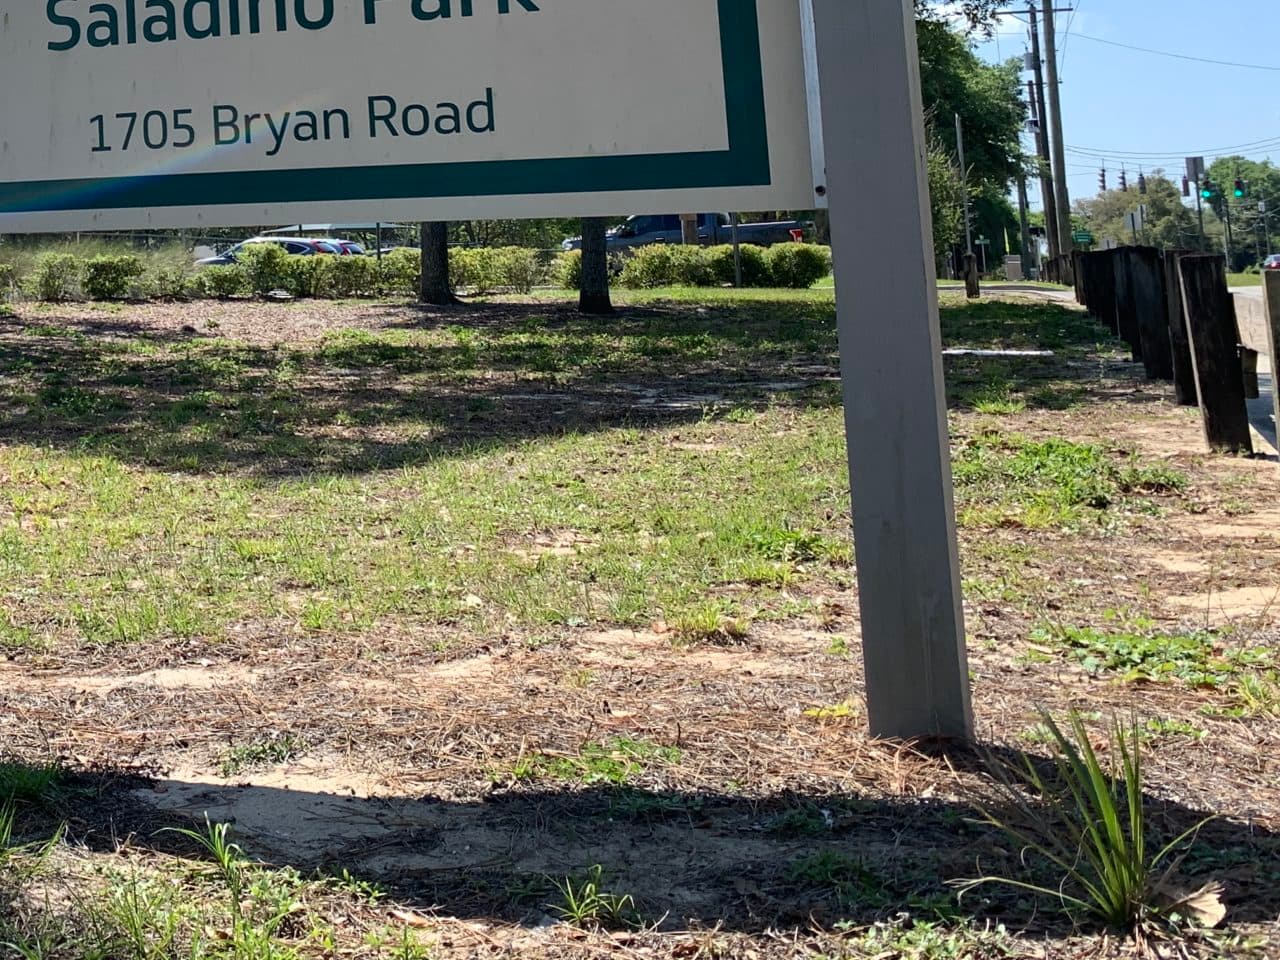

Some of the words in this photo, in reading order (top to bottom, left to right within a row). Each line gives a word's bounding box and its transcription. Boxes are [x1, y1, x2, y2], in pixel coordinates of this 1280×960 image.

[89, 108, 196, 153] 1705
[212, 103, 350, 156] Bryan
[366, 87, 497, 138] Road
